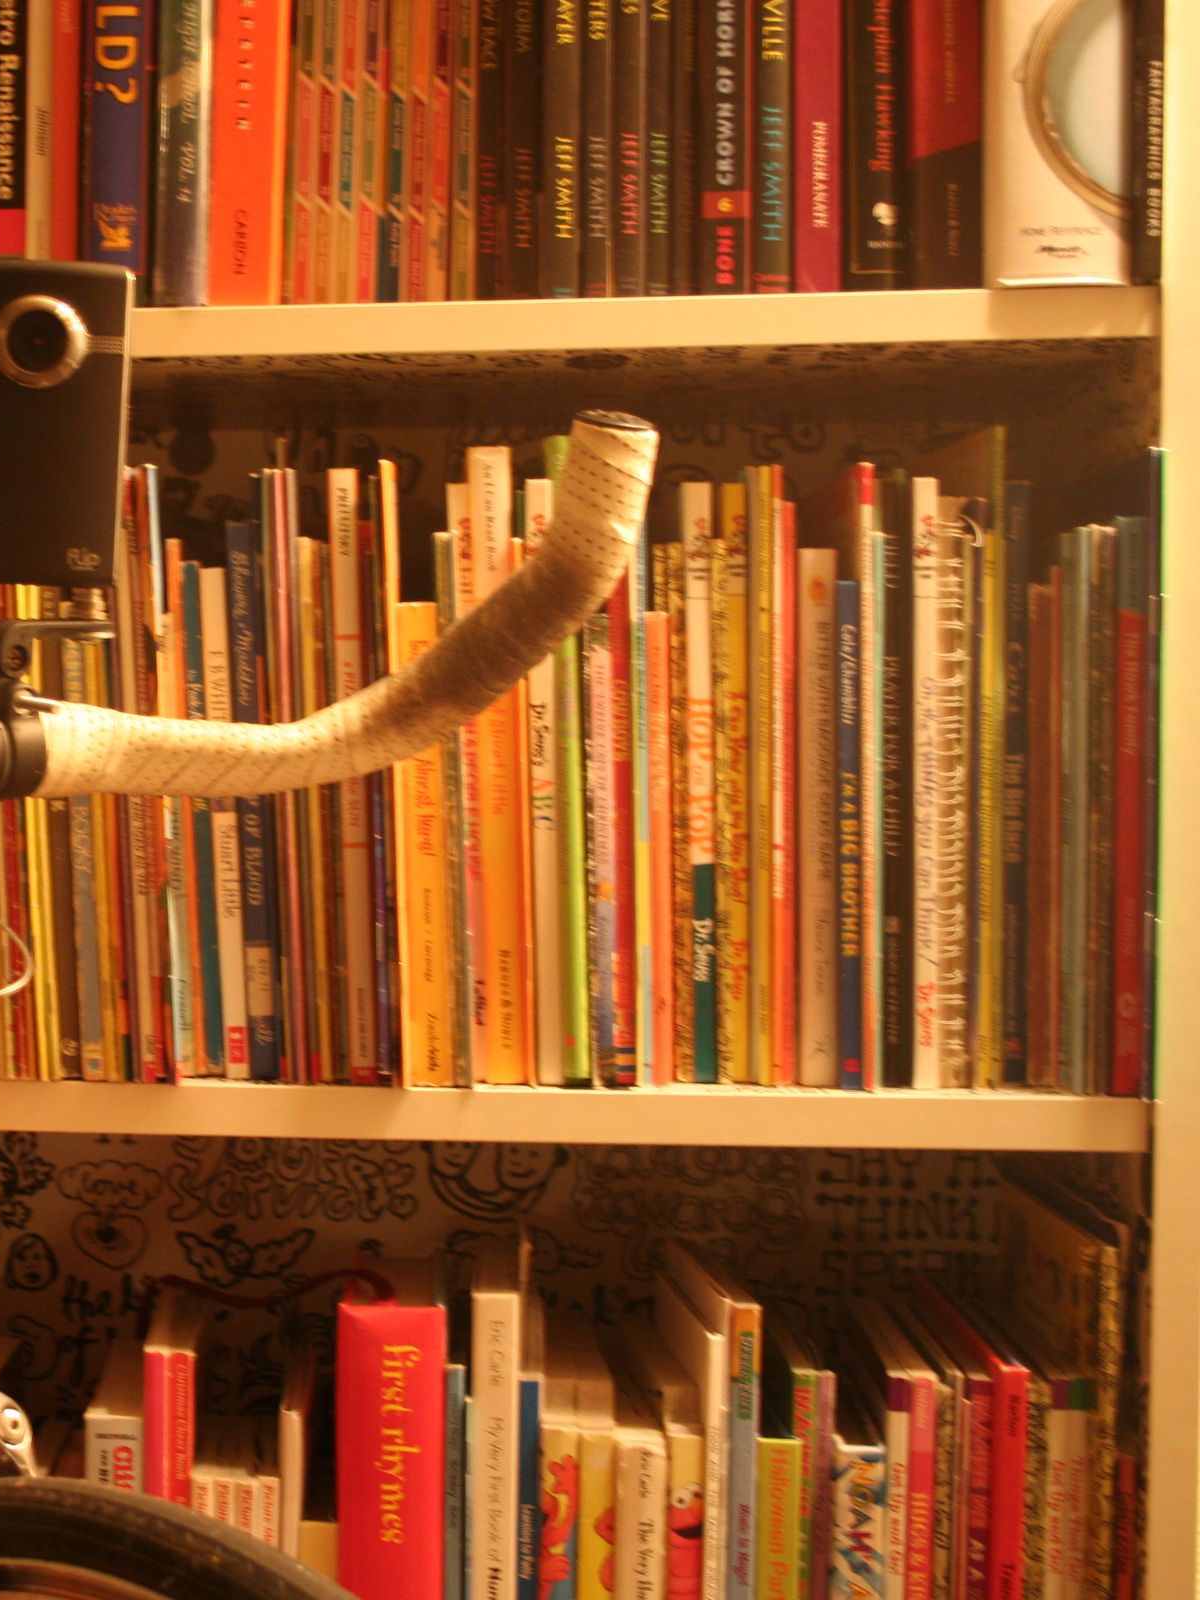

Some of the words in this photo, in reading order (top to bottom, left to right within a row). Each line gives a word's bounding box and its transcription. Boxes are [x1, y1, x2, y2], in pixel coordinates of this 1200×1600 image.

[94, 5, 141, 105] LD?
[715, 65, 736, 95] OF
[35, 107, 51, 157] Johnson
[760, 105, 785, 151] JEFF
[866, 83, 895, 173] Hawking
[1145, 61, 1164, 182] FANTAGRAPHICS
[554, 136, 576, 171] JEFF
[587, 136, 608, 170] JEFF
[619, 132, 641, 167] JEFF
[650, 132, 670, 166] JEFF
[714, 102, 737, 186] CROWN
[810, 121, 830, 229] POMEGRANATE
[554, 177, 576, 240] SMITH
[587, 177, 608, 239] SMITH
[619, 174, 641, 235] SMITH
[650, 174, 670, 235] SMITH
[760, 161, 785, 242] SMITH
[1145, 188, 1163, 238] BOOKS
[714, 226, 736, 286] BONE
[815, 677, 831, 714] WITH
[883, 656, 901, 726] PRAYER
[529, 703, 548, 723] Dr.
[688, 699, 715, 761] HOP
[884, 733, 901, 772] FOR
[412, 758, 434, 809] Almost
[840, 772, 859, 798] I'M
[244, 814, 260, 838] OF
[689, 796, 715, 855] POP
[840, 818, 859, 855] BIG
[884, 795, 902, 857] CHILD
[219, 824, 240, 875] Stuart
[245, 847, 263, 906] BLOOD
[919, 855, 938, 890] Can
[223, 878, 241, 920] Little
[840, 862, 859, 957] BROTHER
[692, 917, 715, 943] Dr.
[498, 950, 512, 996] BARNES
[693, 944, 715, 984] Seuss
[918, 982, 939, 1003] Dr.
[916, 1006, 937, 1048] Seuss
[489, 1319, 506, 1344] Eric
[380, 1343, 421, 1417] first
[490, 1350, 506, 1387] Carle
[486, 1416, 504, 1439] My
[485, 1441, 506, 1473] Very
[374, 1427, 422, 1545] rhymes
[489, 1475, 506, 1504] First
[639, 1472, 654, 1499] Carle
[767, 1449, 790, 1554] Halloween
[489, 1508, 506, 1544] Book
[519, 1503, 535, 1544] Learning
[638, 1518, 656, 1544] The
[909, 1491, 928, 1549] HUGS
[489, 1548, 505, 1563] of
[519, 1554, 535, 1580] Potty
[634, 1549, 654, 1577] Very
